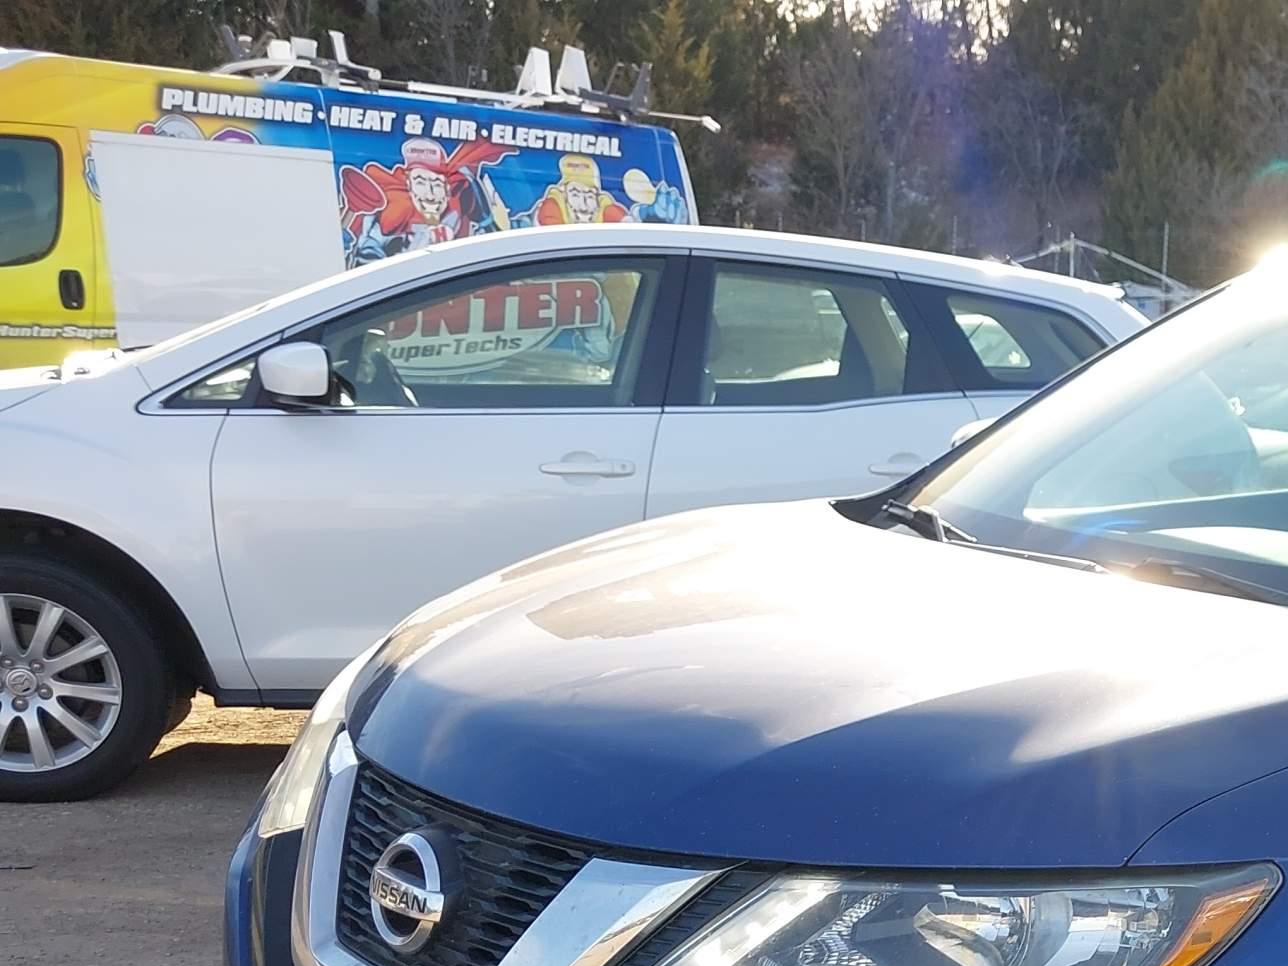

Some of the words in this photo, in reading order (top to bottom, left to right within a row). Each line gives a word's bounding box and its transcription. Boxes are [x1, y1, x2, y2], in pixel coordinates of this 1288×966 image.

[161, 87, 314, 125] PLUMBING
[329, 105, 397, 133] HEAT
[404, 114, 424, 136] &
[432, 117, 477, 142] AIR
[491, 124, 622, 158] ELECTRICAL
[385, 281, 600, 341] UNTER
[386, 334, 523, 363] uperTechs
[371, 868, 428, 914] NISSAN
